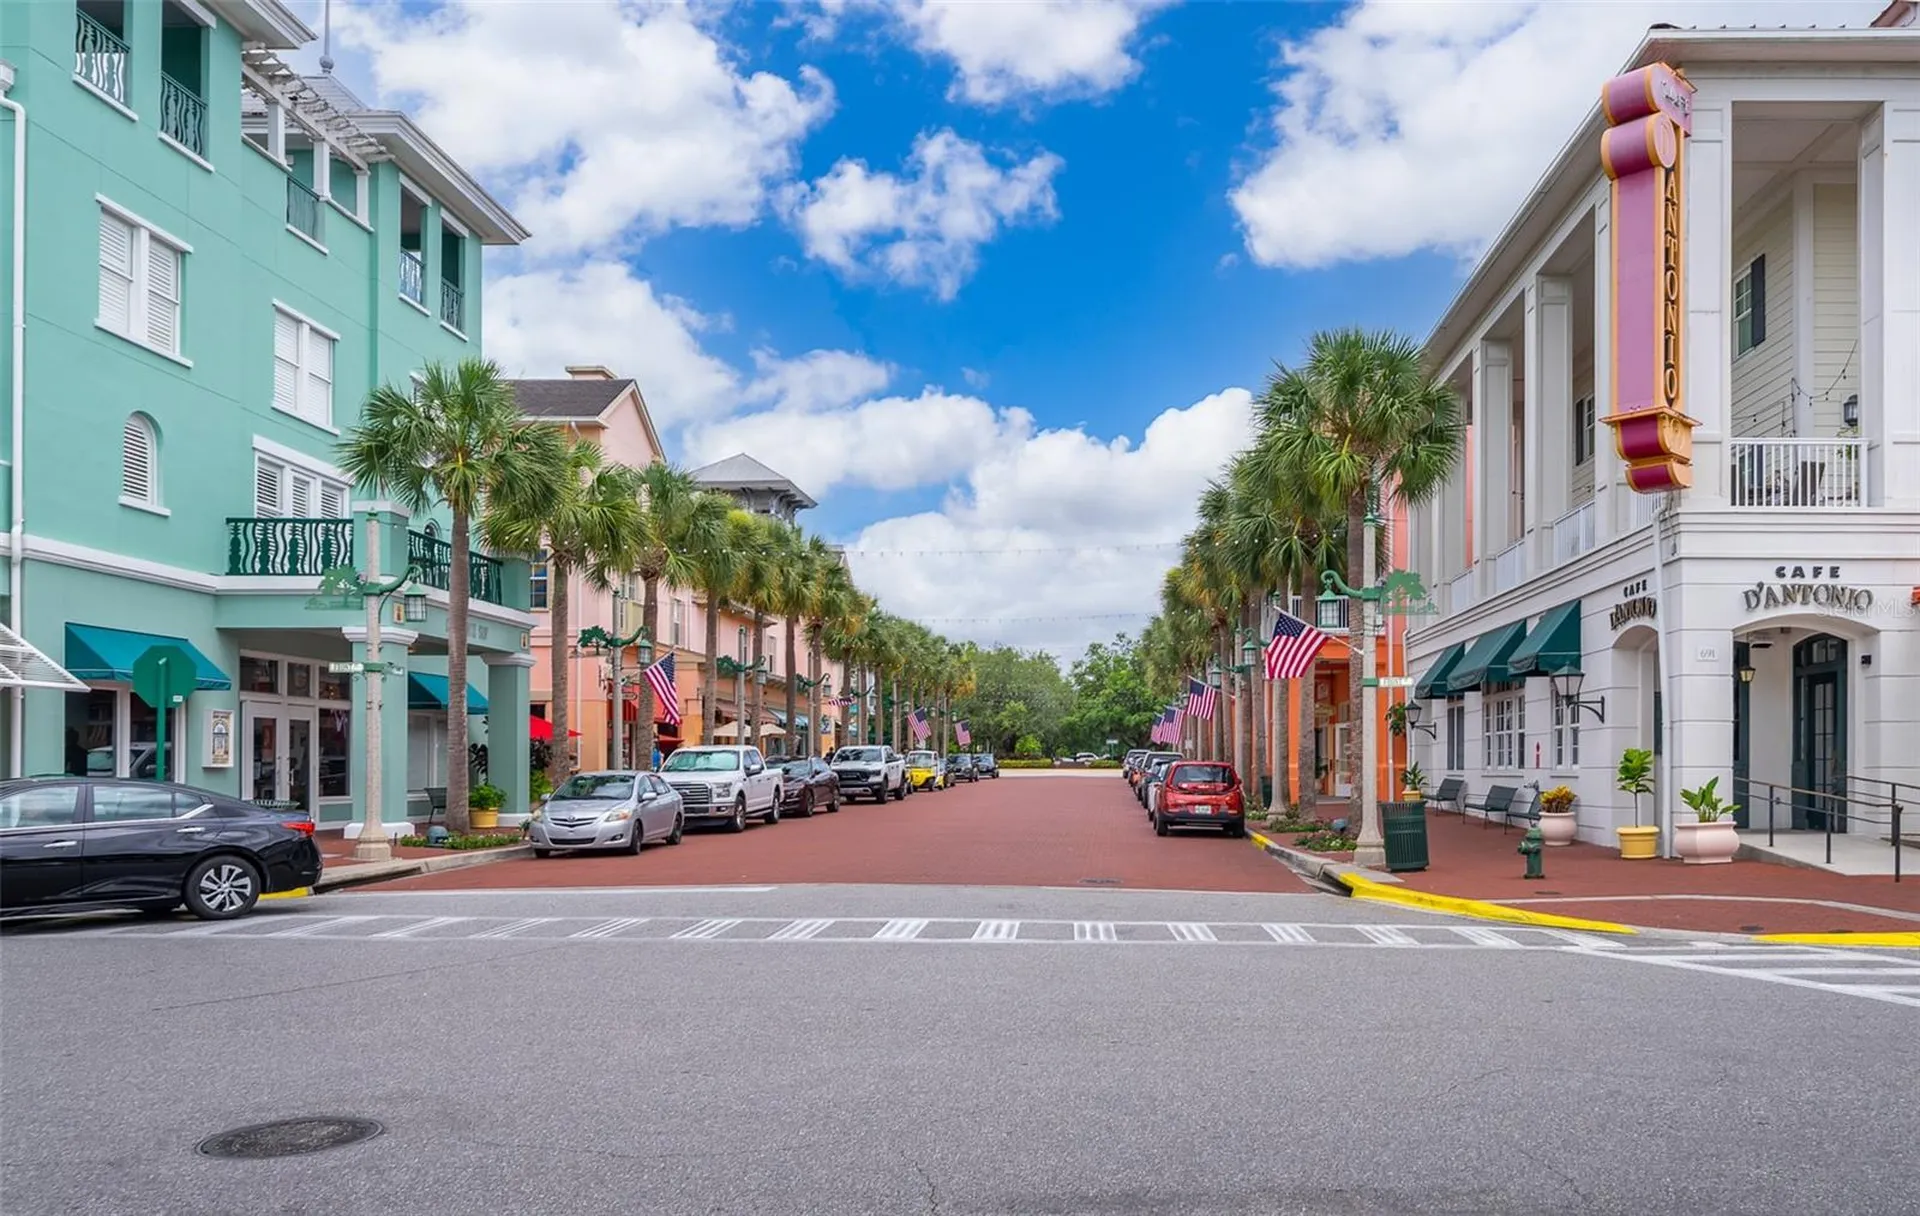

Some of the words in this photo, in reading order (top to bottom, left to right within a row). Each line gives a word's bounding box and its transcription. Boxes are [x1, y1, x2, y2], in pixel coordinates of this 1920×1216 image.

[1775, 566, 1840, 578] CAFE
[1623, 579, 1647, 598] CAFE
[1742, 582, 1873, 612] D'ANTONIO
